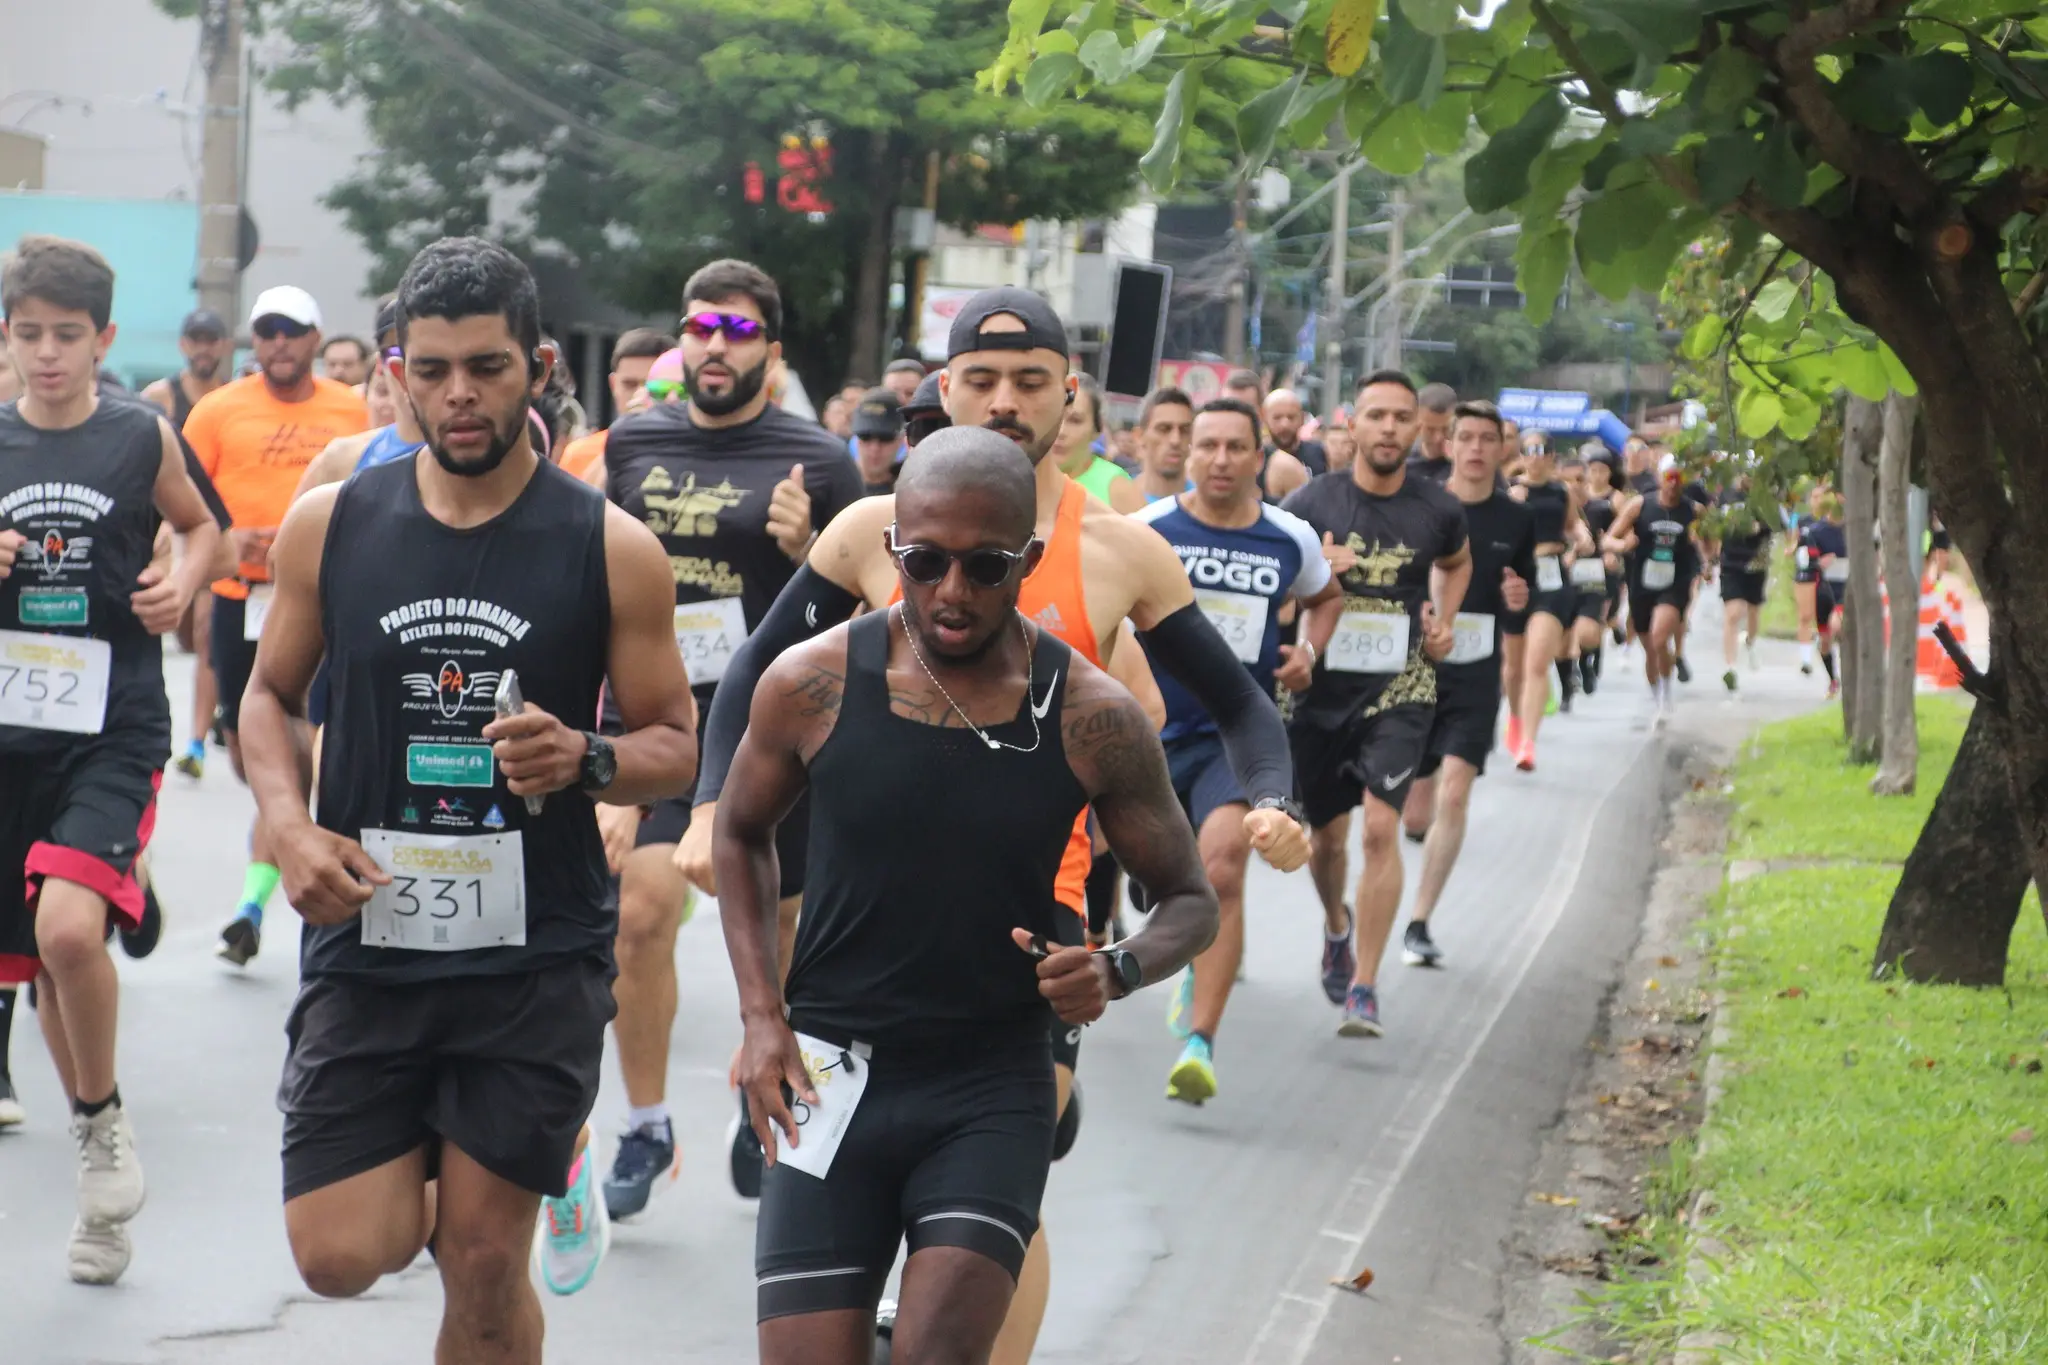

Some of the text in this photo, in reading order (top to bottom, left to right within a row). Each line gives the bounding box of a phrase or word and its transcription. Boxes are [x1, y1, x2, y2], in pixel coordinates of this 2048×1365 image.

[1210, 547, 1228, 561] DE
[1229, 550, 1280, 570] CORRIDA
[379, 597, 532, 641] PROJETO DO AMANHÃ
[400, 622, 509, 648] ATLETA DO FUTURO
[1338, 632, 1394, 656] 380
[0, 664, 79, 706] 752
[440, 671, 463, 693] PA
[415, 753, 465, 767] Unimed
[392, 875, 482, 918] 331
